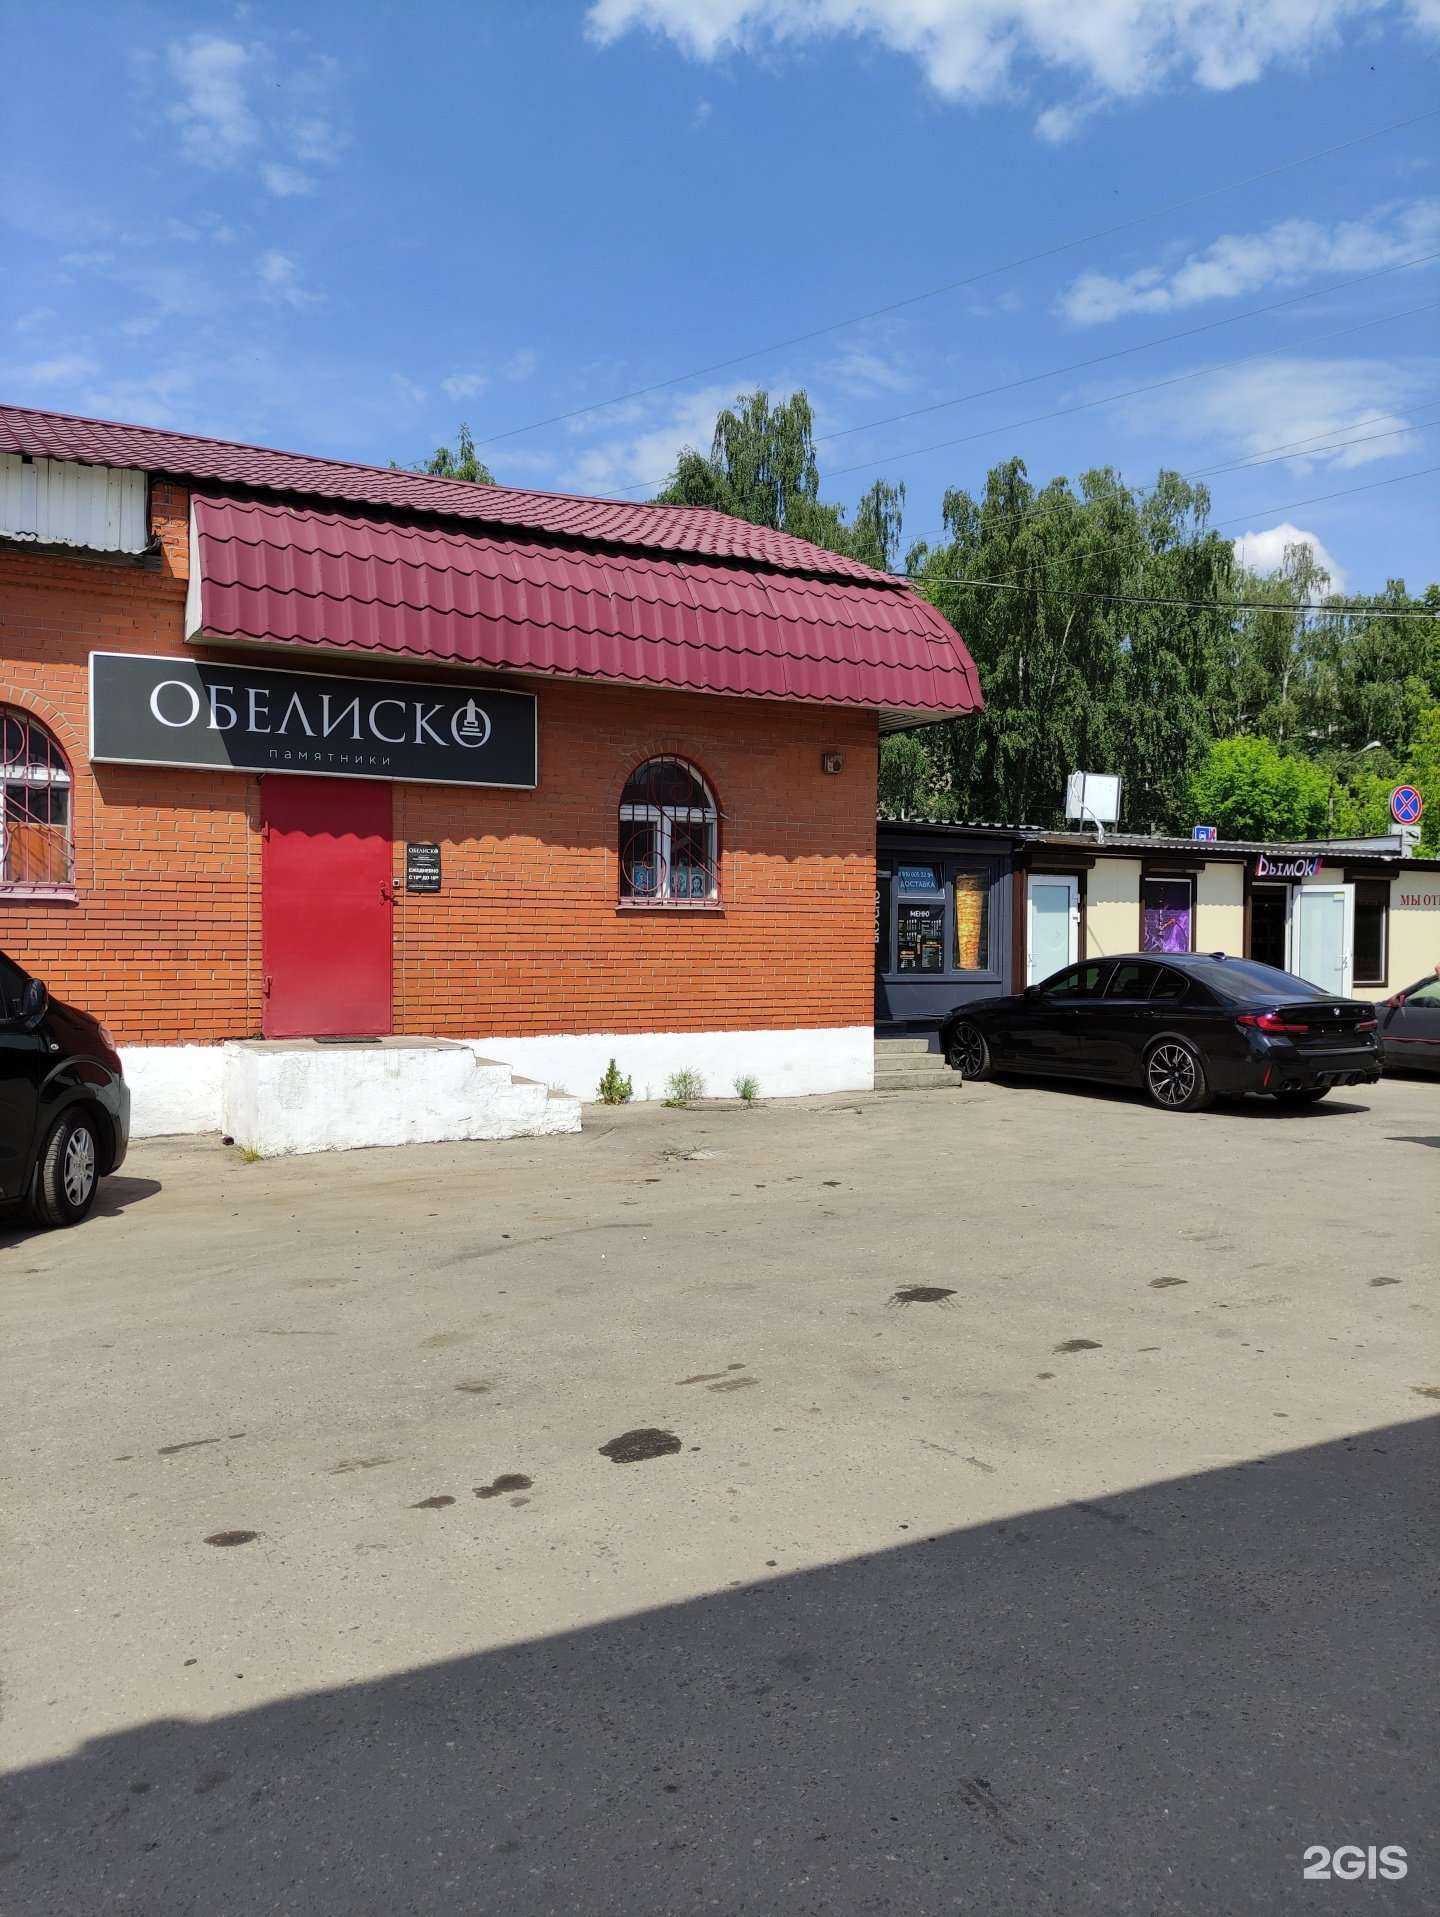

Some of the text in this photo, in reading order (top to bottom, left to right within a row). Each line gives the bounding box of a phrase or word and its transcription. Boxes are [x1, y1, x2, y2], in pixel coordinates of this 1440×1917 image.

[268, 749, 392, 766] памятники
[900, 880, 936, 888] ДОСТАВКА
[1400, 894, 1440, 906] МЫ ОТ
[909, 910, 930, 918] МЕНЮ
